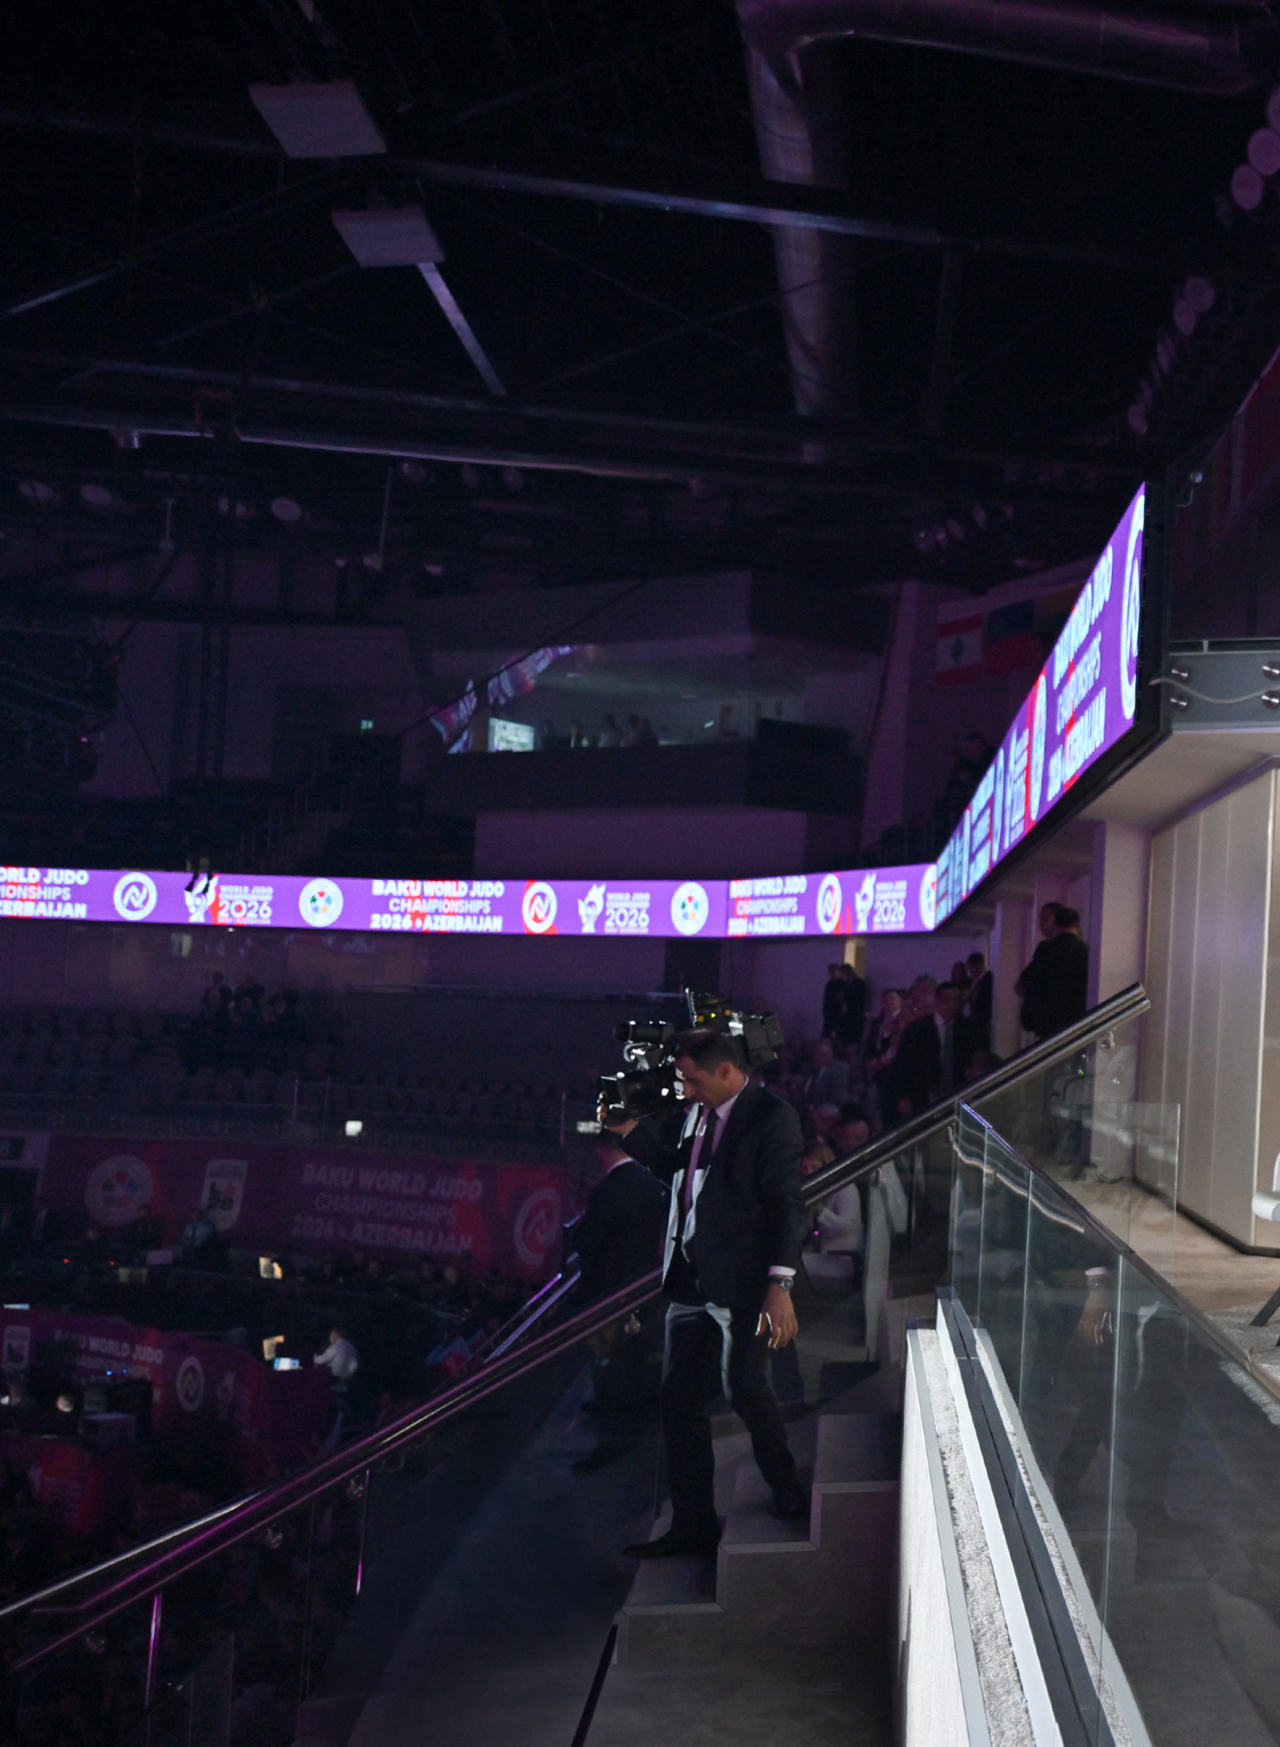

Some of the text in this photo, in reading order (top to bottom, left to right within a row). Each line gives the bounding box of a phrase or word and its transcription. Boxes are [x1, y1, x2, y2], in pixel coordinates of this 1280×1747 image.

[0, 867, 90, 886] ORLD JUDO
[0, 884, 71, 901] IONSHIPS
[372, 879, 505, 898] BAKU WORLD JUDO
[0, 900, 87, 918] ERBAIJAN
[217, 899, 273, 919] 2026
[388, 897, 492, 914] CHAMPIONSHIPS
[873, 900, 906, 923] 2026
[370, 913, 503, 932] 2026 AZERBAIJAN
[605, 908, 650, 928] 2026
[302, 1163, 483, 1201] BAKU WORLD JUDO
[314, 1192, 458, 1226] CHAMPIONSHIPS
